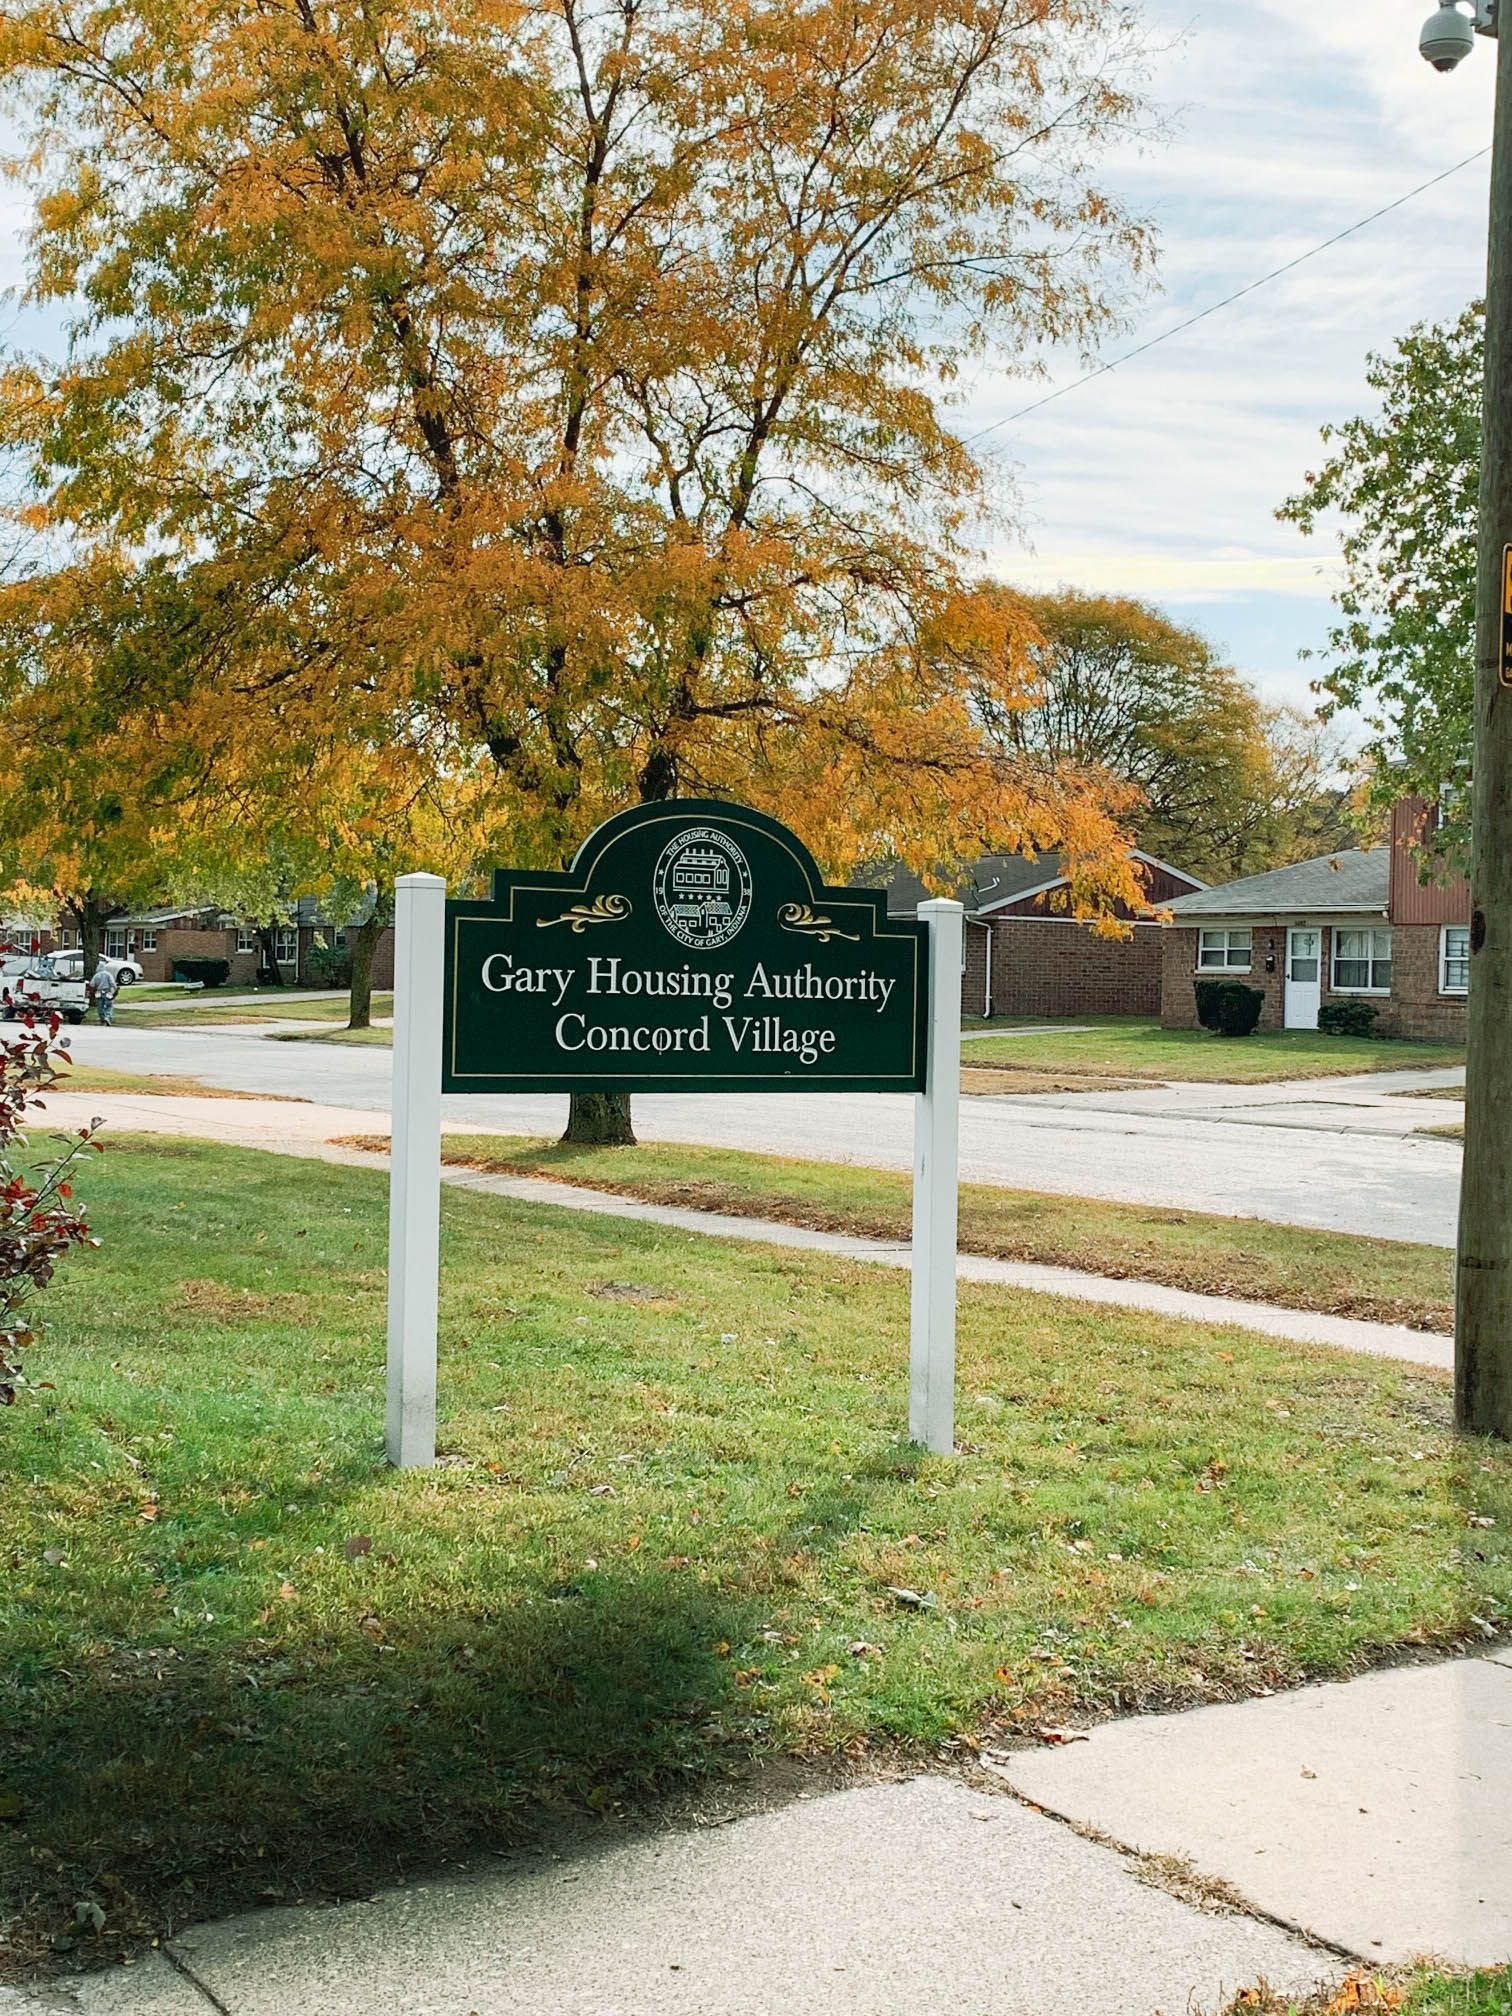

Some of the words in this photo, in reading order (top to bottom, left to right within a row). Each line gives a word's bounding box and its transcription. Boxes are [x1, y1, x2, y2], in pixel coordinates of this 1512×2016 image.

[666, 842, 679, 856] THE
[679, 830, 709, 845] HOUSING
[710, 832, 743, 864] AUTHORITY
[665, 917, 677, 933] THE
[677, 930, 694, 944] CITY
[727, 905, 747, 936] INDIANA
[481, 953, 576, 1007] Gary
[586, 957, 735, 1010] Housing
[743, 963, 896, 1013] Authority
[555, 1013, 711, 1052] Concord
[721, 1016, 836, 1065] Village
